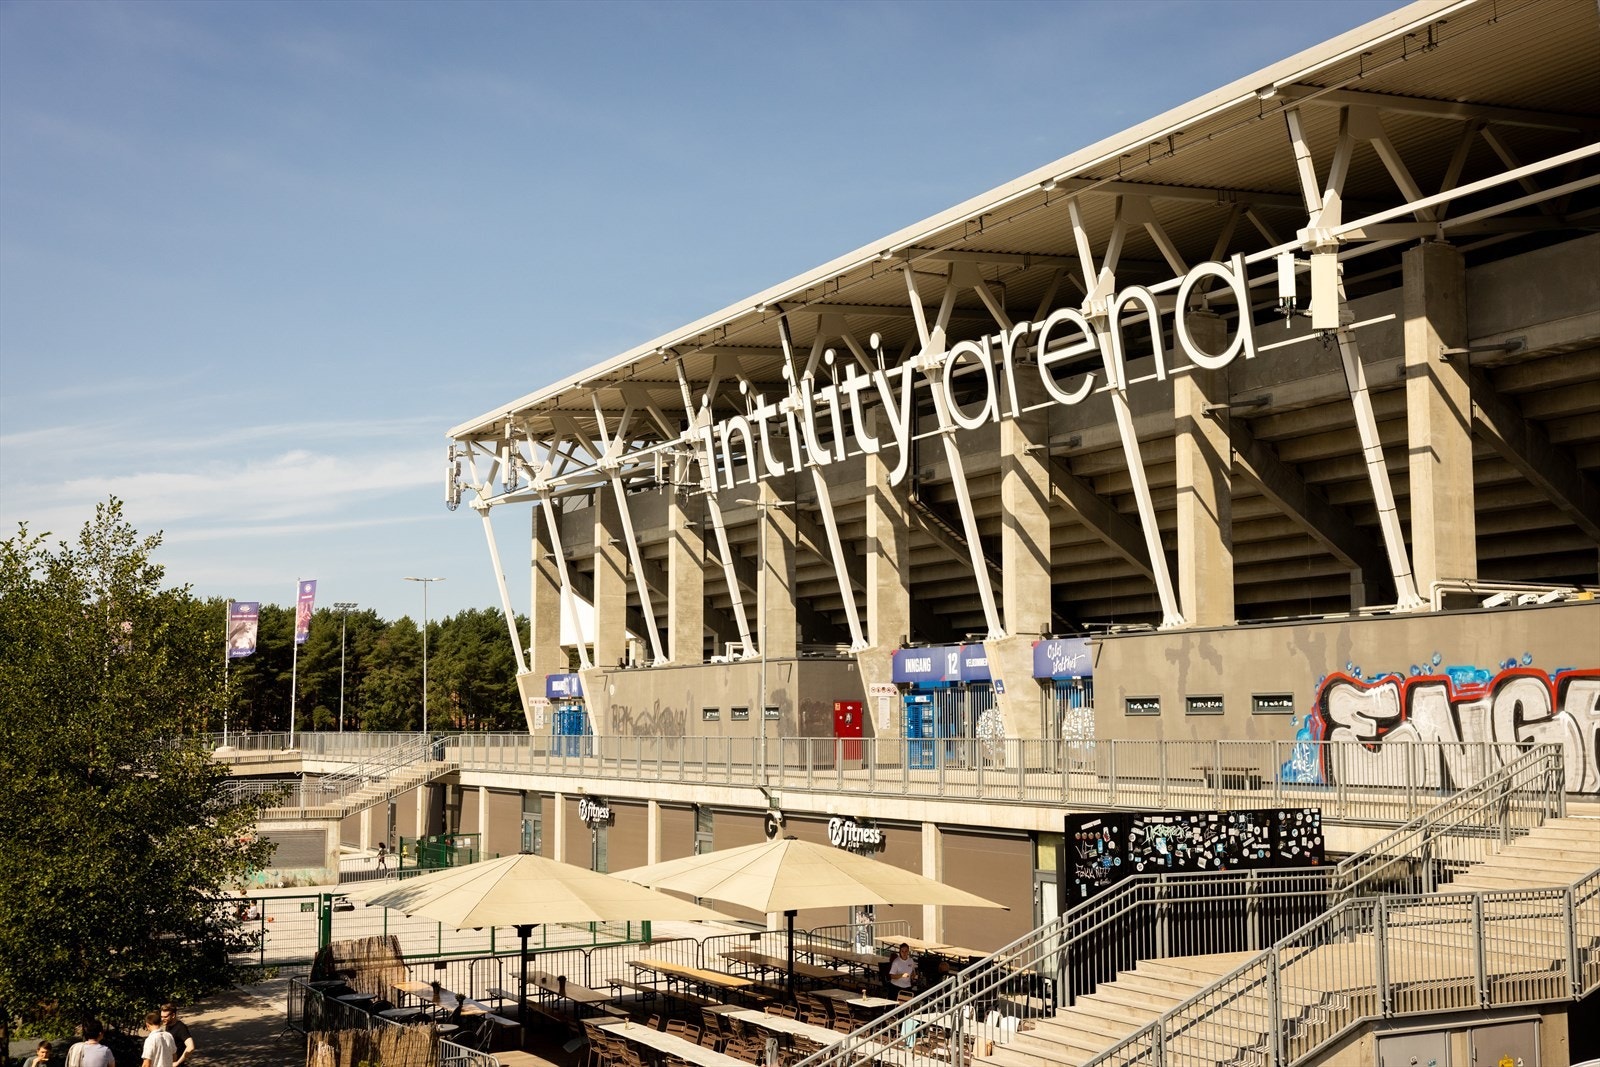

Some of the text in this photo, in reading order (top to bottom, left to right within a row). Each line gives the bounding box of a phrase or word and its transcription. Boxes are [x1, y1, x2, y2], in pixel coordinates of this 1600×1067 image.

[700, 251, 1256, 491] intility arena
[905, 652, 958, 675] INNGANG 12
[842, 820, 880, 847] fitness
[847, 840, 861, 848] club
